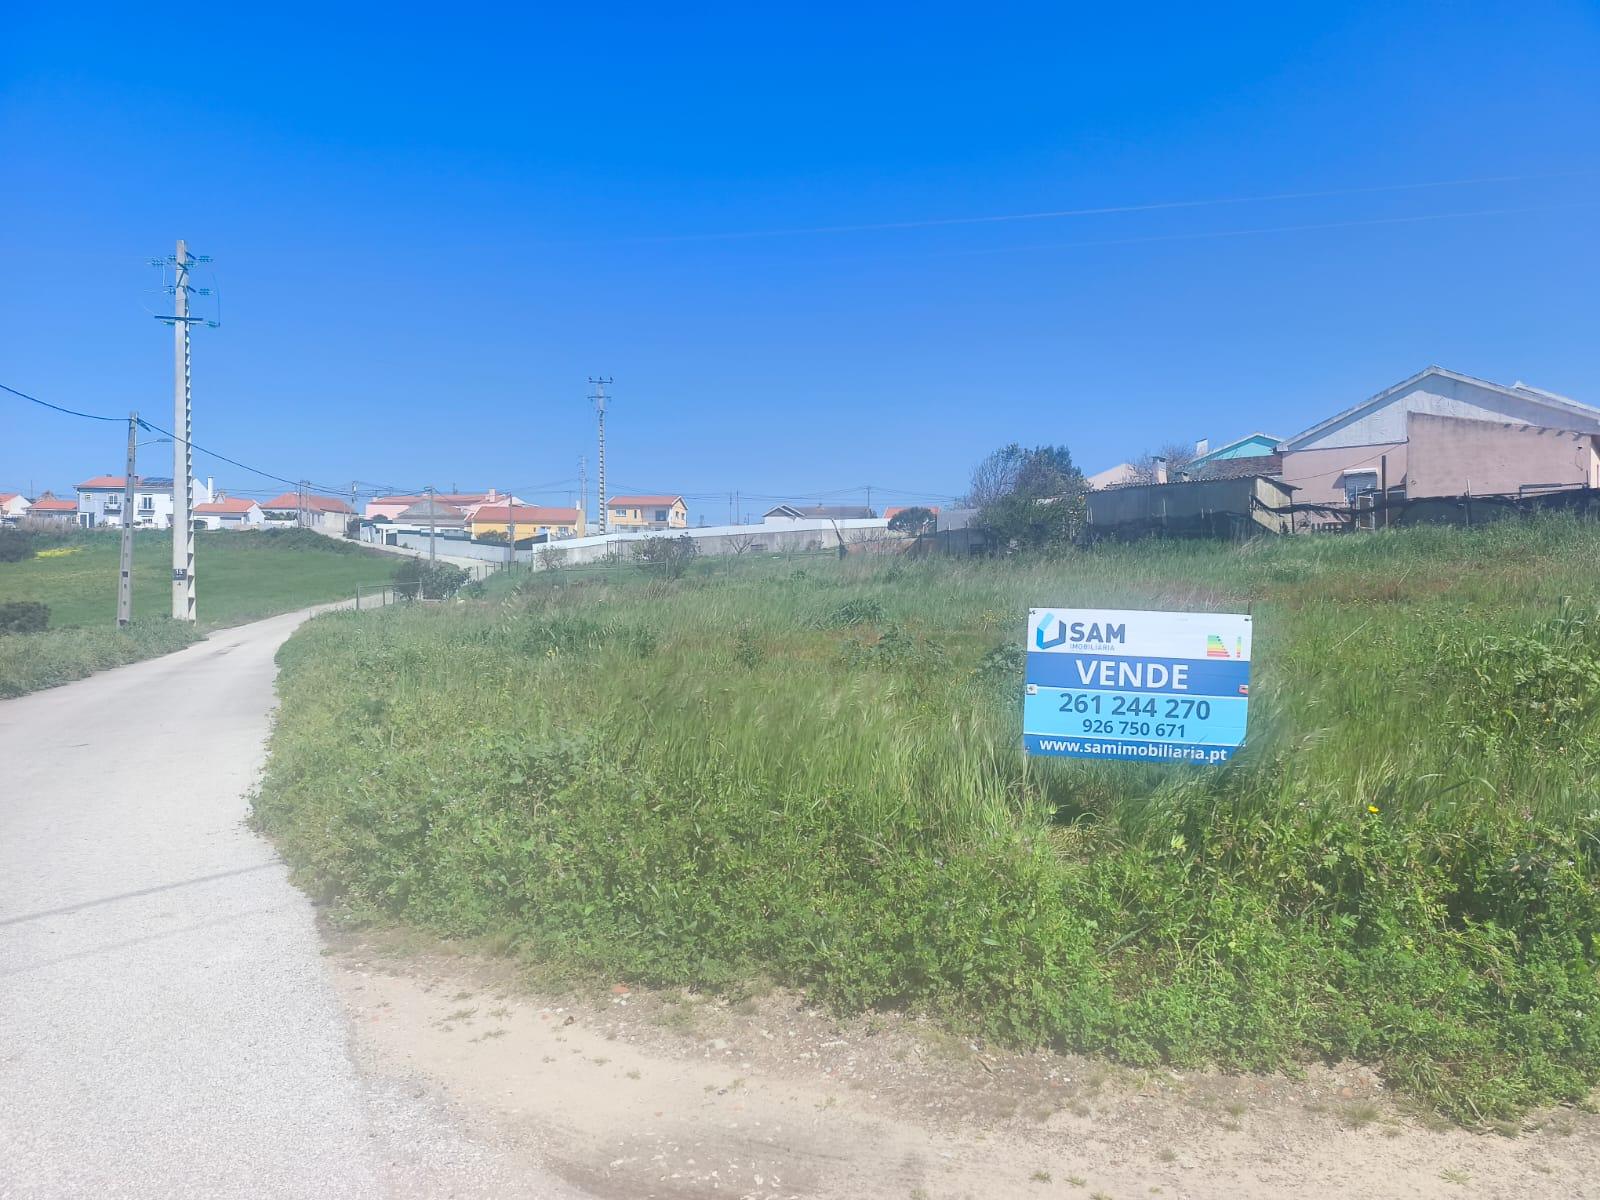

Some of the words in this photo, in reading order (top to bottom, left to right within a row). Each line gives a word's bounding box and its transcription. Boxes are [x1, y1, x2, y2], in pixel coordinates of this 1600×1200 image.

[1069, 622, 1126, 644] SAM
[1075, 659, 1189, 690] VENDE
[1059, 692, 1101, 714] 261
[1112, 695, 1157, 718] 244
[1165, 699, 1210, 720] 270
[1082, 718, 1113, 734] 926
[1120, 720, 1150, 736] 750
[1155, 722, 1185, 738] 671
[1039, 738, 1227, 764] www.samimobiliaria.pt
